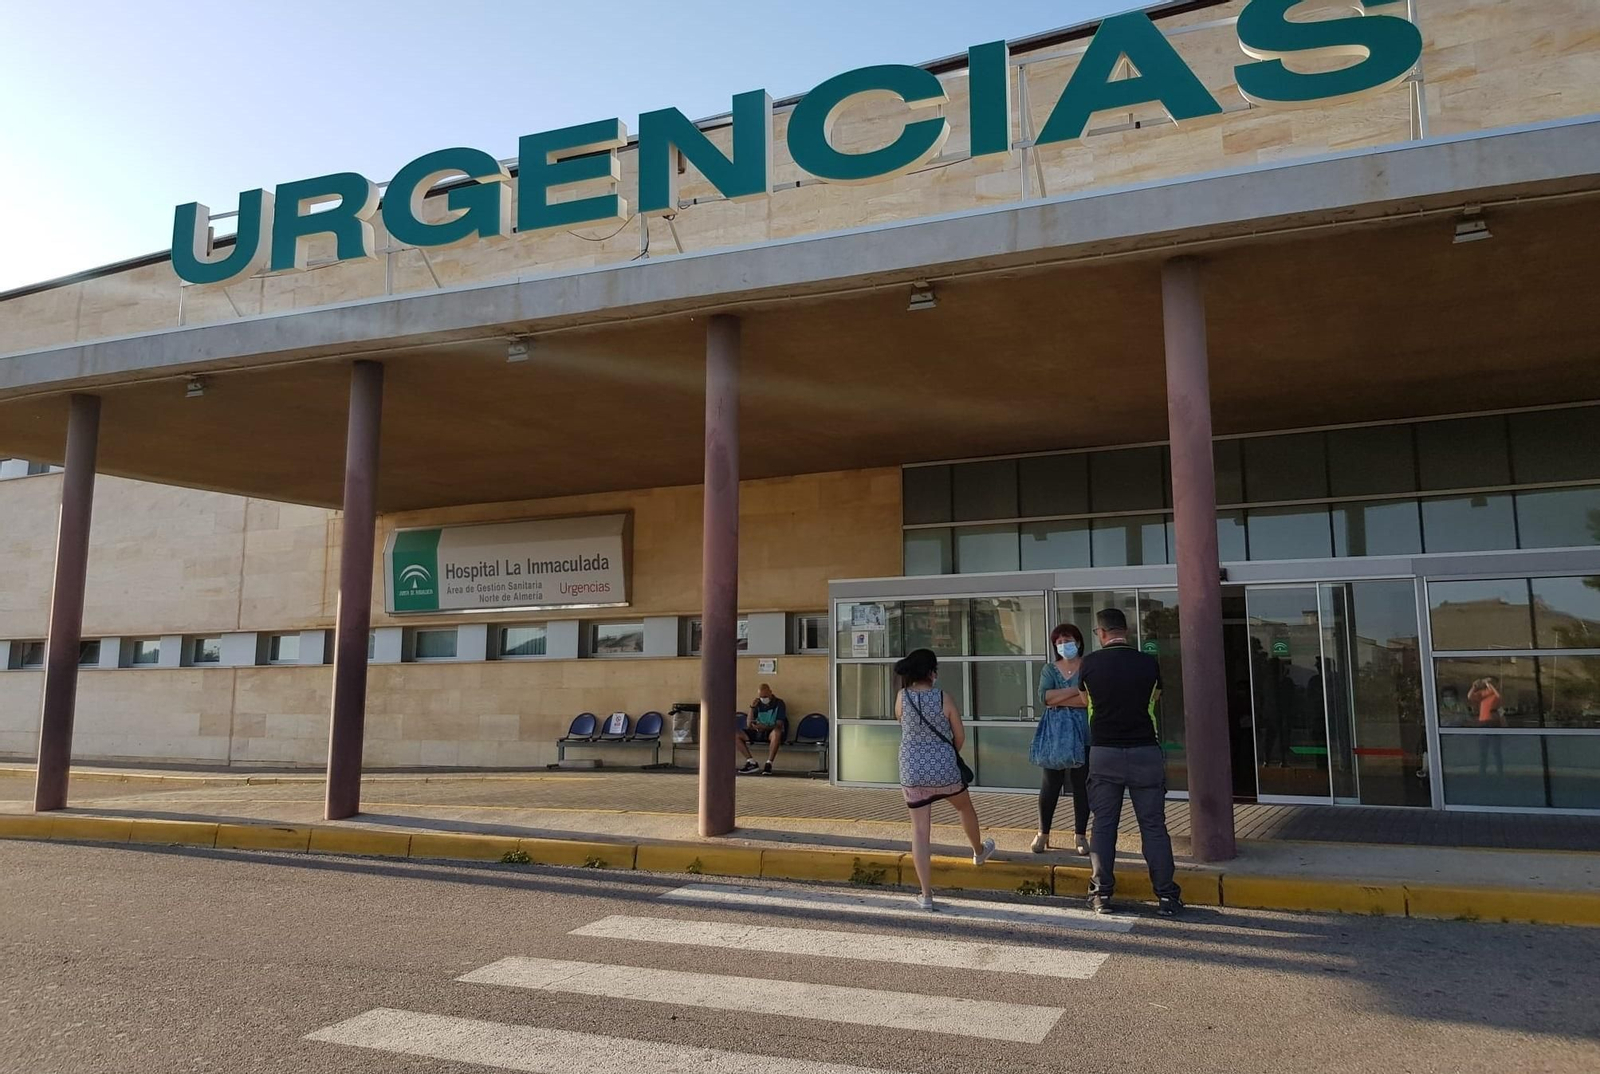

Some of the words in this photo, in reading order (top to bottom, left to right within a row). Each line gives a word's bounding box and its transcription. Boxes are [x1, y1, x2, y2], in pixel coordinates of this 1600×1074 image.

[171, 0, 1423, 285] URGENCIAS
[446, 560, 499, 582] Hospital
[506, 559, 521, 576] La
[527, 553, 609, 575] Inmaculada
[446, 583, 463, 594] Área
[466, 584, 475, 593] de
[477, 582, 506, 592] Gestión
[508, 580, 543, 590] Sanitaria
[560, 581, 611, 596] Urgencias
[480, 593, 500, 603] Norte
[502, 593, 511, 601] de
[514, 591, 543, 601] Almería
